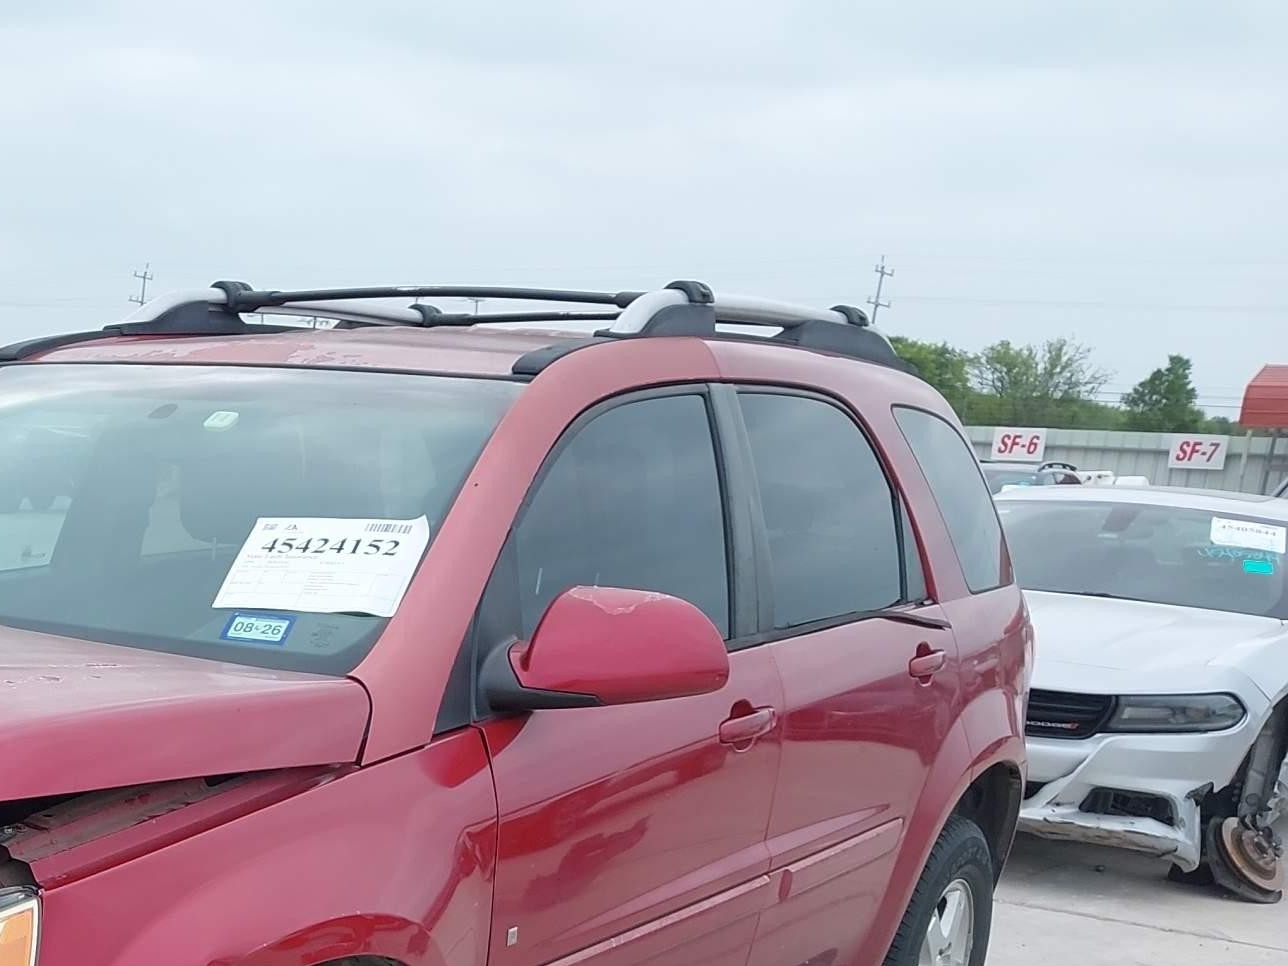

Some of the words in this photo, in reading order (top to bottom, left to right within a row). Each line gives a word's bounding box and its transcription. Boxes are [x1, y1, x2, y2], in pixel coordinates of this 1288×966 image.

[998, 434, 1040, 455] SF-6
[1175, 440, 1221, 463] SF-7
[261, 537, 400, 556] 45424152
[233, 621, 254, 633] 08
[260, 623, 283, 636] 26
